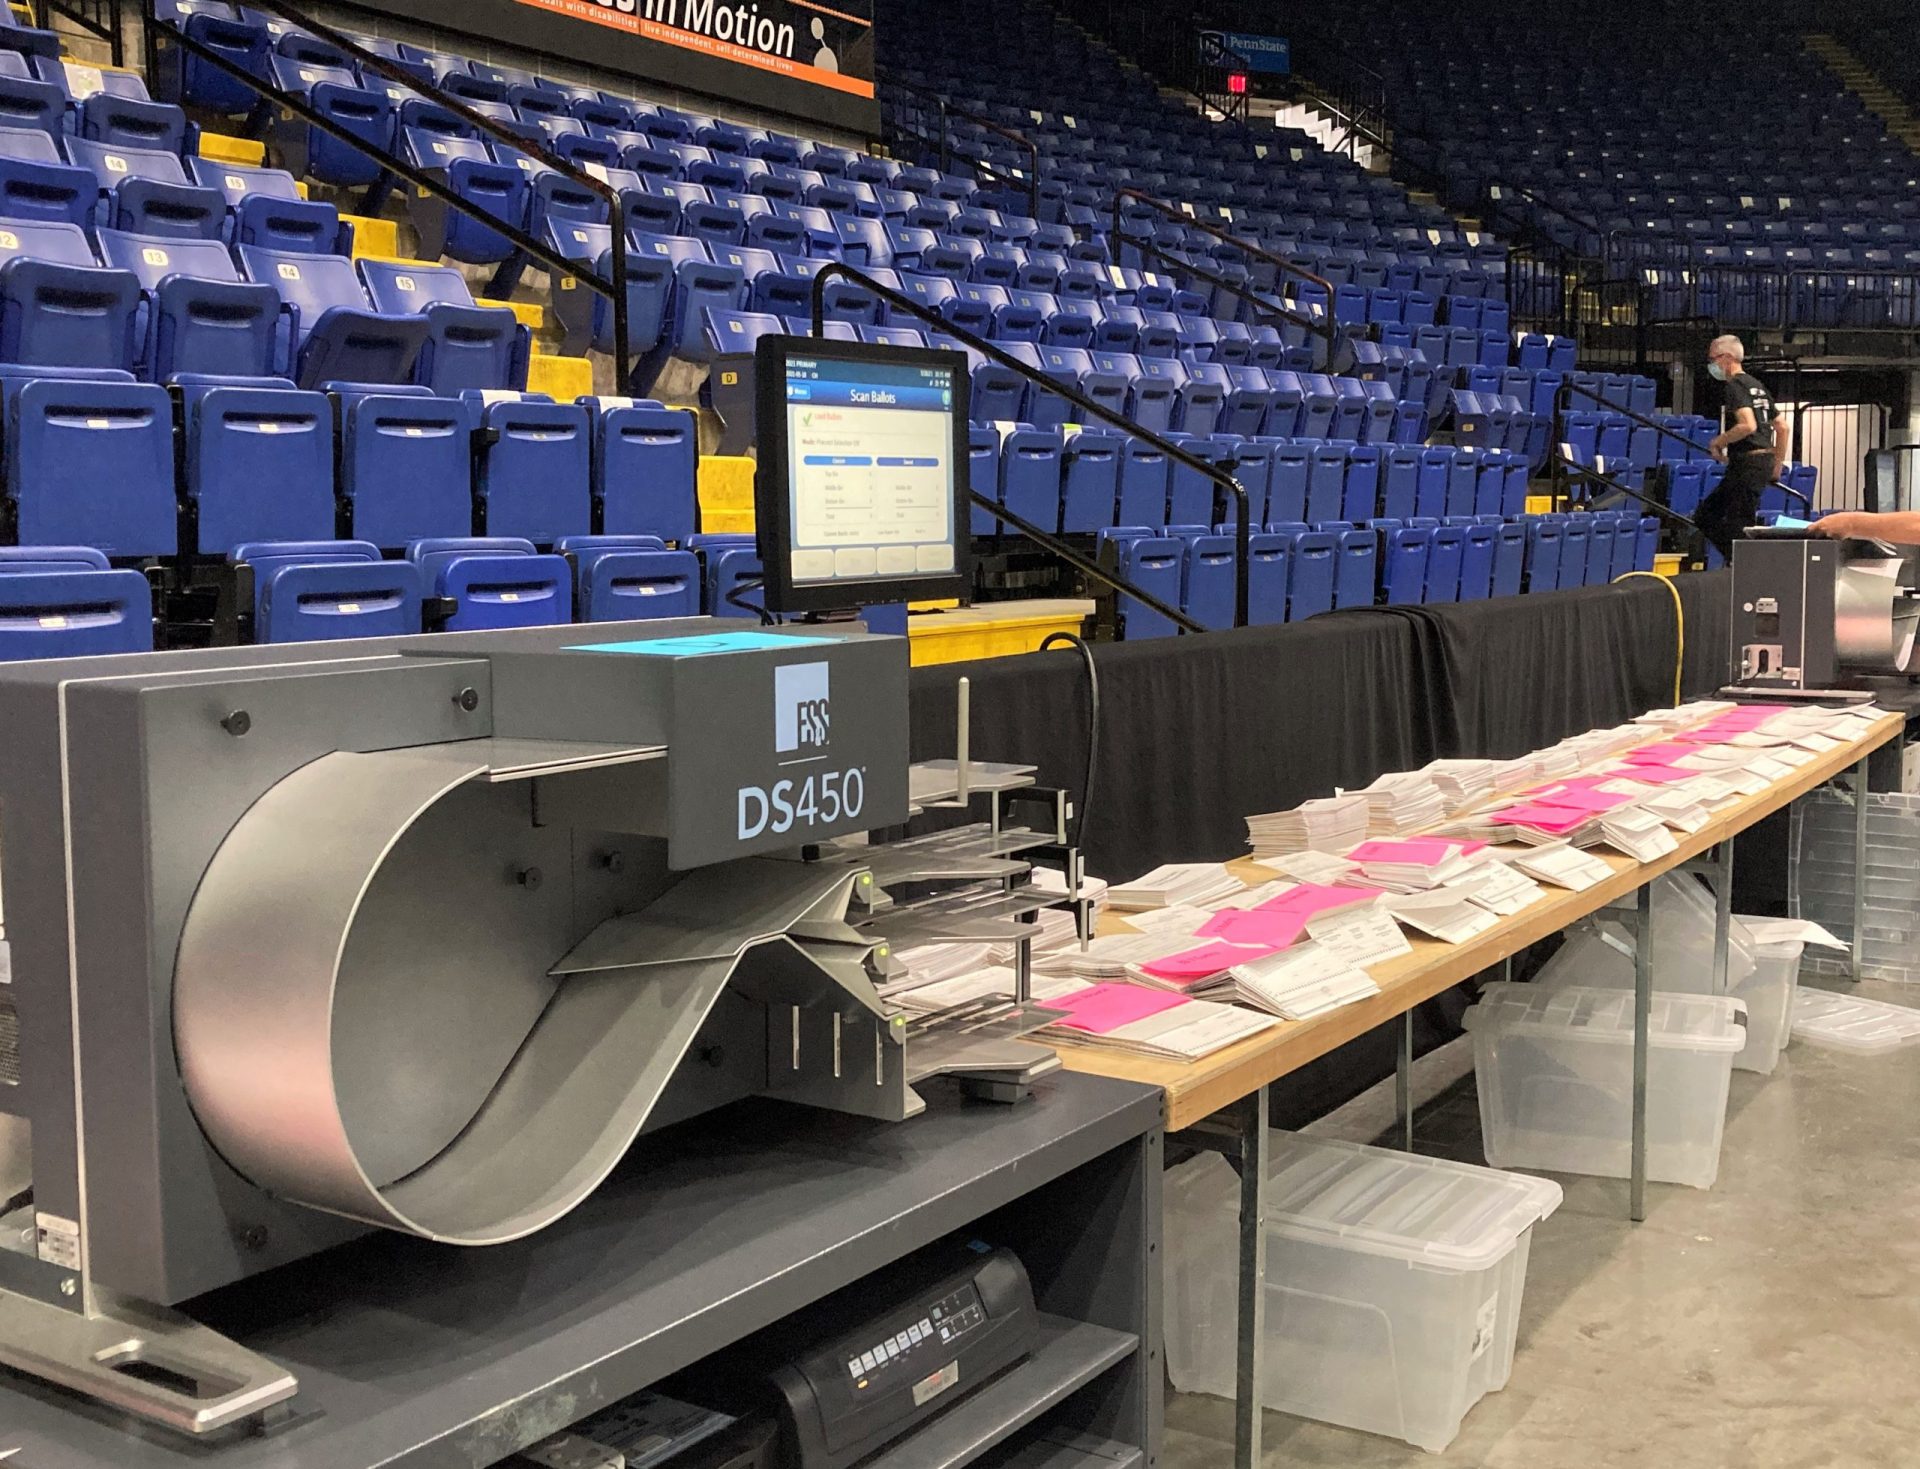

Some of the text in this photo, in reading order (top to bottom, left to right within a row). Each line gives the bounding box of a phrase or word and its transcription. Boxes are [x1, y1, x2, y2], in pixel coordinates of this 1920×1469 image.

[683, 0, 795, 58] Motion
[565, 2, 587, 15] with
[588, 7, 638, 29] disabilities
[644, 22, 661, 36] live
[776, 59, 794, 72] lives
[110, 159, 123, 169] 14
[229, 178, 242, 188] 15
[148, 251, 163, 263] 13
[282, 266, 296, 278] 14
[399, 278, 412, 290] 15
[726, 372, 733, 384] D
[850, 389, 896, 404] Scan Ballots
